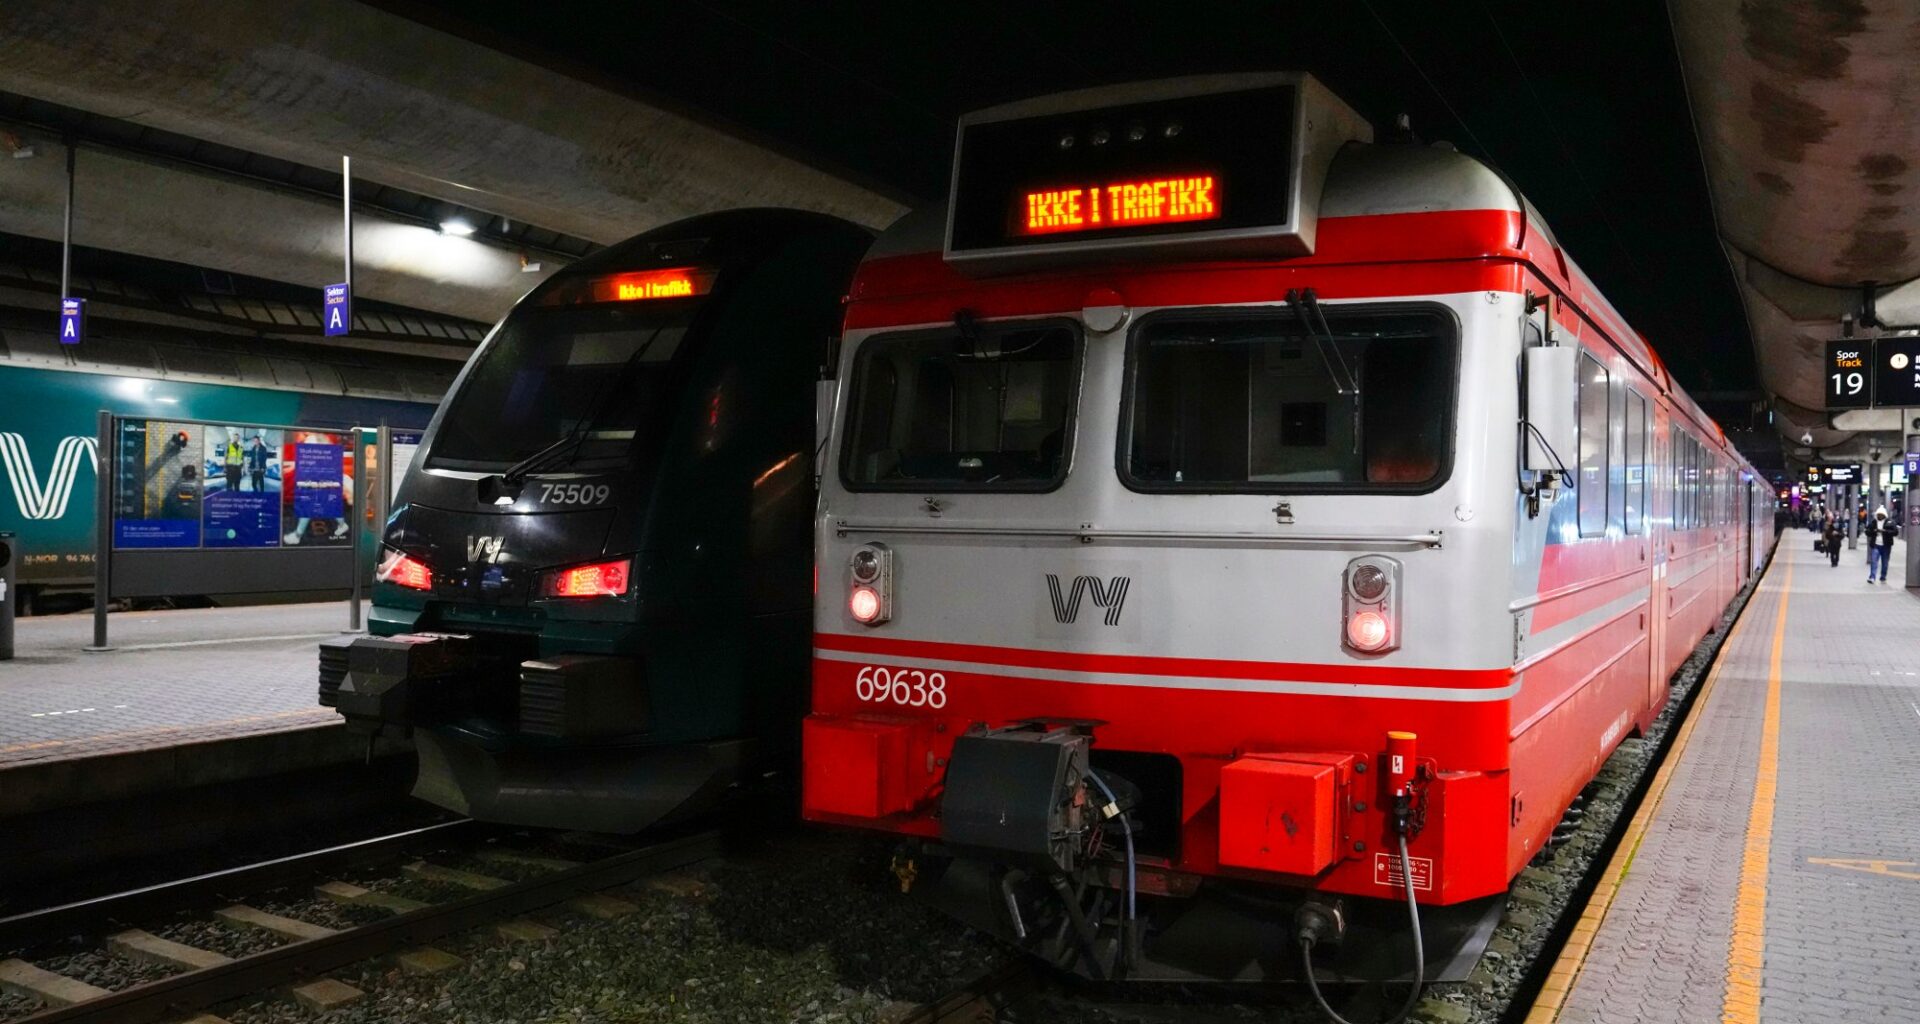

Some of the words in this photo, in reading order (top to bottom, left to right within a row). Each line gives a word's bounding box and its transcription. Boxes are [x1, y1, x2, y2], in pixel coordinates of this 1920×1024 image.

[1028, 190, 1083, 228] IKKE
[1091, 188, 1100, 222] I
[1108, 177, 1213, 221] TRAFIKK
[619, 284, 643, 300] Ikke
[652, 280, 691, 297] trafikk
[64, 318, 75, 337] A
[330, 307, 342, 328] A
[1836, 350, 1859, 360] Spor
[1836, 358, 1862, 367] Track
[1832, 372, 1864, 395] 19
[1909, 461, 1917, 471] B
[538, 483, 610, 505] 75509
[856, 666, 947, 709] 69638
